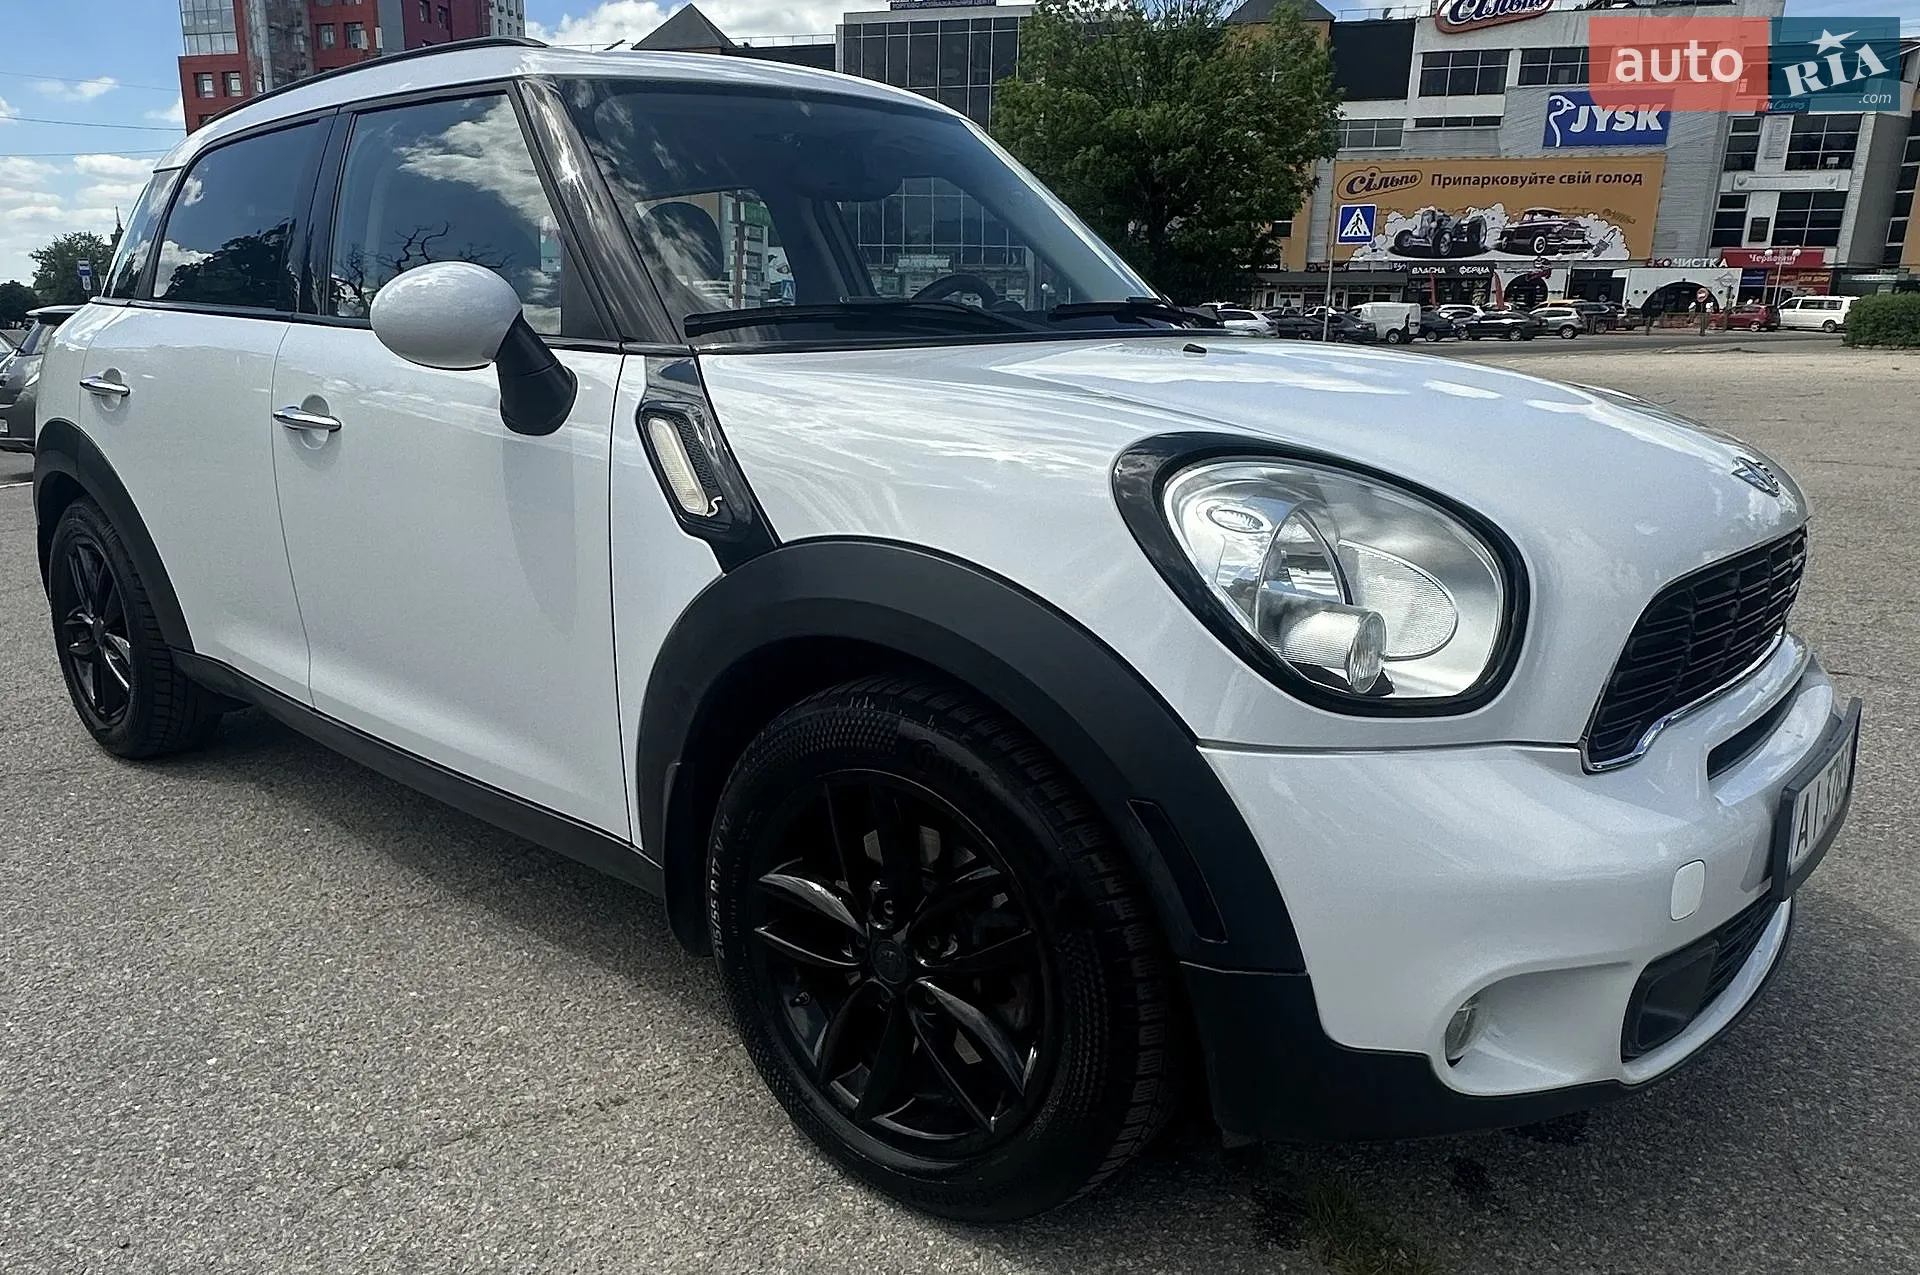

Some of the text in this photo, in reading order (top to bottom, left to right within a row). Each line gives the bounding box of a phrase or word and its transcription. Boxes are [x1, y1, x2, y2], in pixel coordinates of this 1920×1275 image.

[1569, 102, 1664, 133] JYSK
[1346, 172, 1418, 195] Сільпо
[1431, 171, 1643, 189] Припарковуйте свій голод
